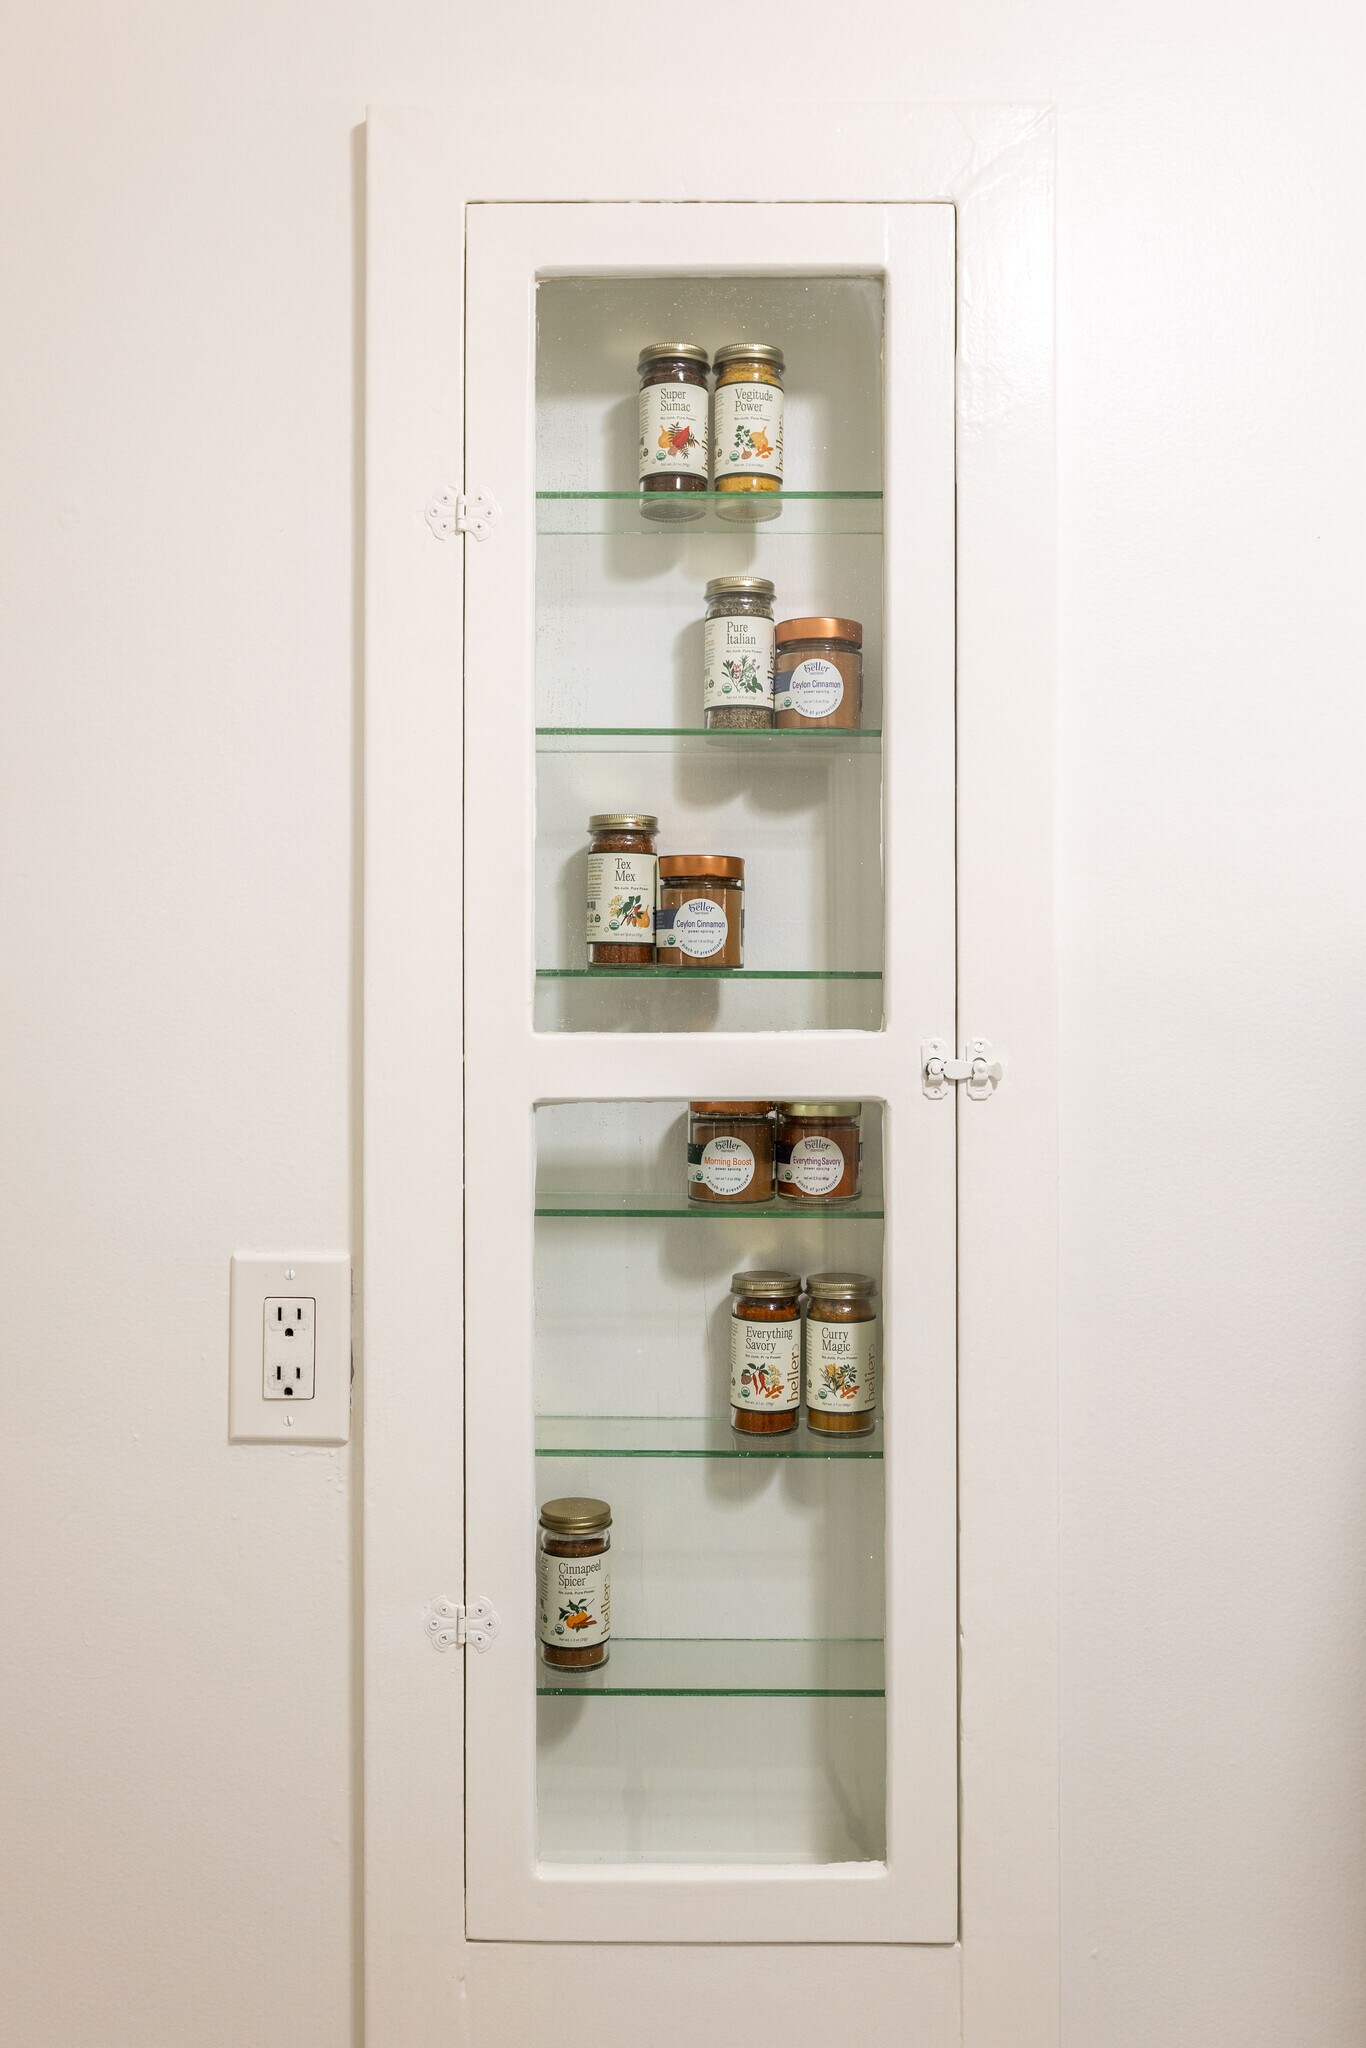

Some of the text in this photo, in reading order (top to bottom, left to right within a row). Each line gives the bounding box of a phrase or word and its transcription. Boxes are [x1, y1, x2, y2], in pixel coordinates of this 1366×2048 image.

[660, 388, 687, 401] Super
[735, 388, 774, 402] Vegitude
[660, 400, 691, 412] Sumac
[735, 400, 763, 412] Power
[726, 621, 748, 633] Pure
[726, 633, 756, 645] Italian
[792, 679, 841, 690] Ceylon Cinnamon
[614, 857, 631, 870] Tex
[614, 870, 636, 882] Mex
[676, 919, 696, 929] Ceylon
[696, 919, 726, 928] Cinnamon
[703, 1156, 752, 1167] Morning Boost
[792, 1155, 842, 1167] Everything Savory
[745, 1325, 793, 1341] Everything
[821, 1326, 849, 1343] Curry
[745, 1337, 776, 1354] Savory
[821, 1339, 851, 1354] Magic
[558, 1559, 602, 1577] Cinnapeel
[558, 1574, 586, 1589] Spicer
